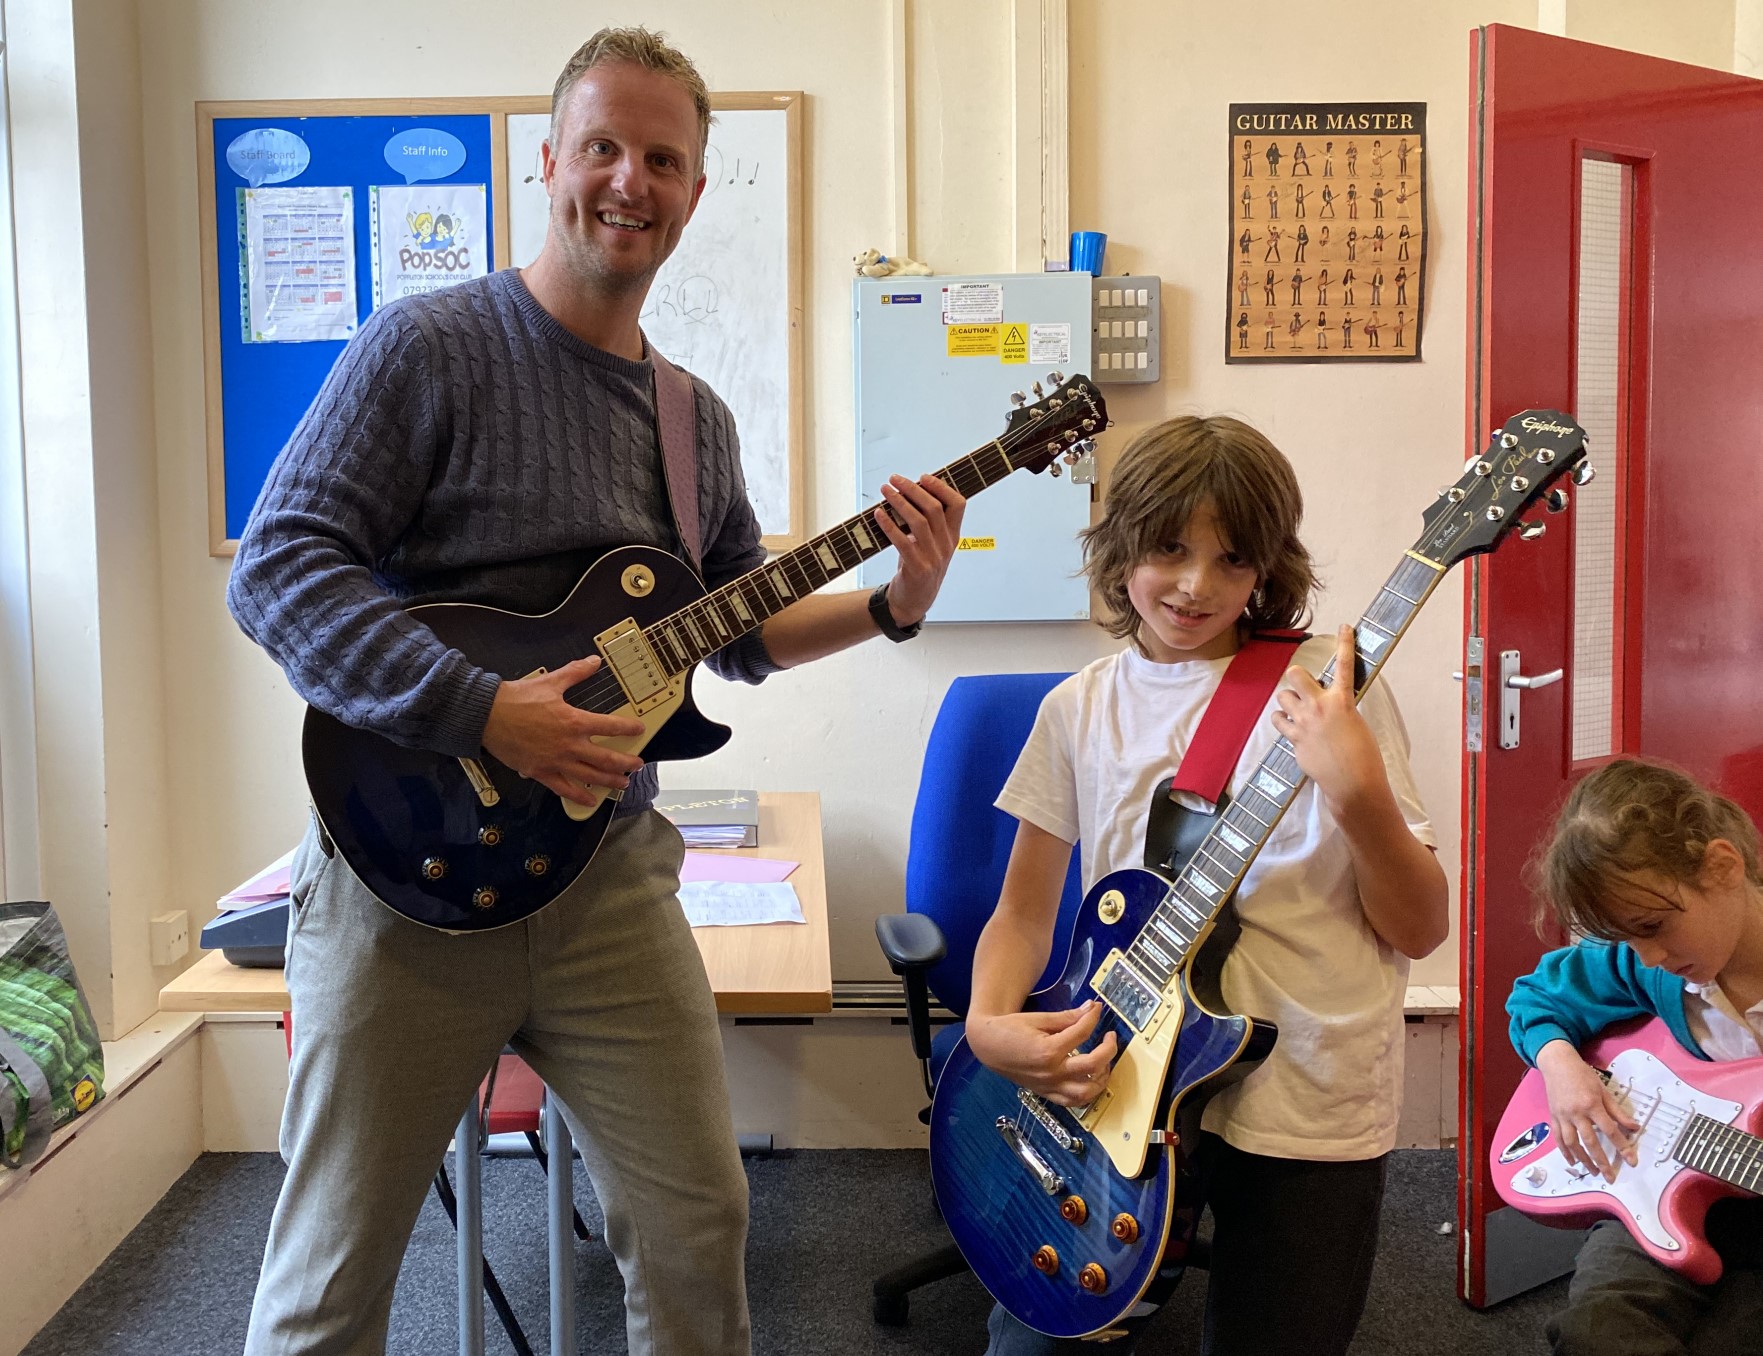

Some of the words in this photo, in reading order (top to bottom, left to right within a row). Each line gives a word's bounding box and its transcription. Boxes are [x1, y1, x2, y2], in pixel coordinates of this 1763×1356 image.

[1236, 113, 1318, 130] GUITAR
[1326, 113, 1414, 130] MASTER
[240, 149, 264, 160] Staff
[266, 149, 296, 160] Board
[402, 145, 426, 156] Staff
[429, 146, 448, 157] Info
[958, 327, 990, 335] CAUTION
[1078, 383, 1101, 419] Epiphone
[1521, 416, 1575, 438] Epiphone
